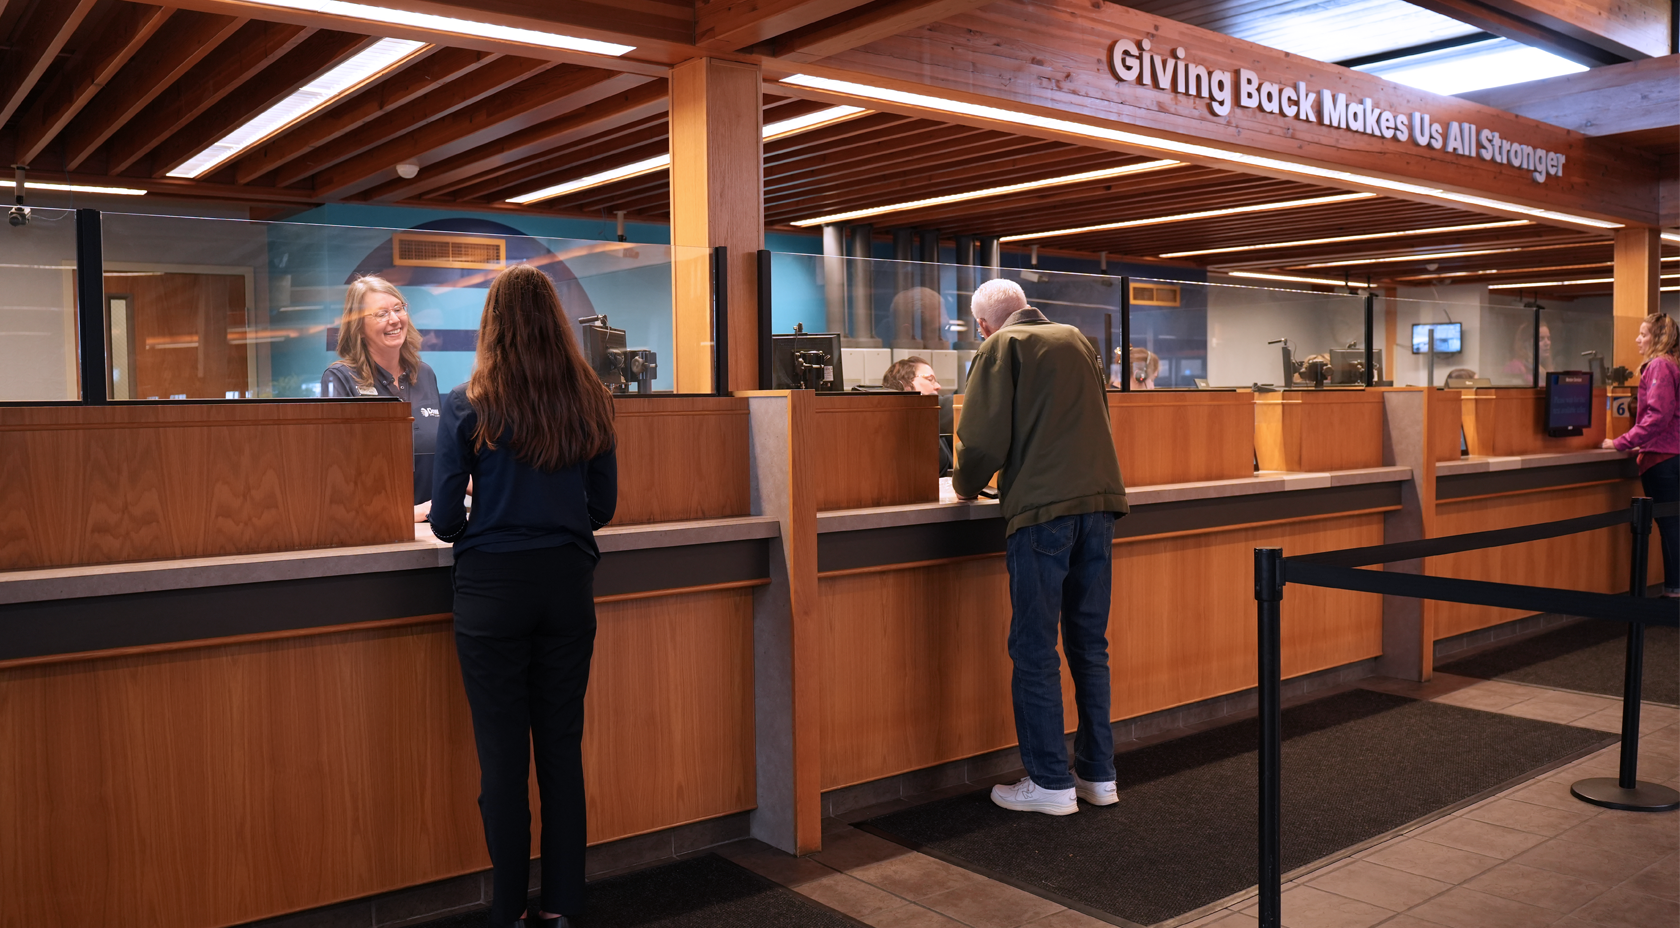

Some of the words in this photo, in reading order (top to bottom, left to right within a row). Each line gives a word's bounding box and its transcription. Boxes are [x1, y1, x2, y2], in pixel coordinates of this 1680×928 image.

[1111, 38, 1231, 116] Giving
[1237, 67, 1317, 122] Back
[1320, 88, 1408, 142] Makes
[1411, 111, 1443, 151] Us
[1445, 121, 1477, 157] All
[1478, 128, 1566, 183] Stronger
[1617, 402, 1625, 416] 6
